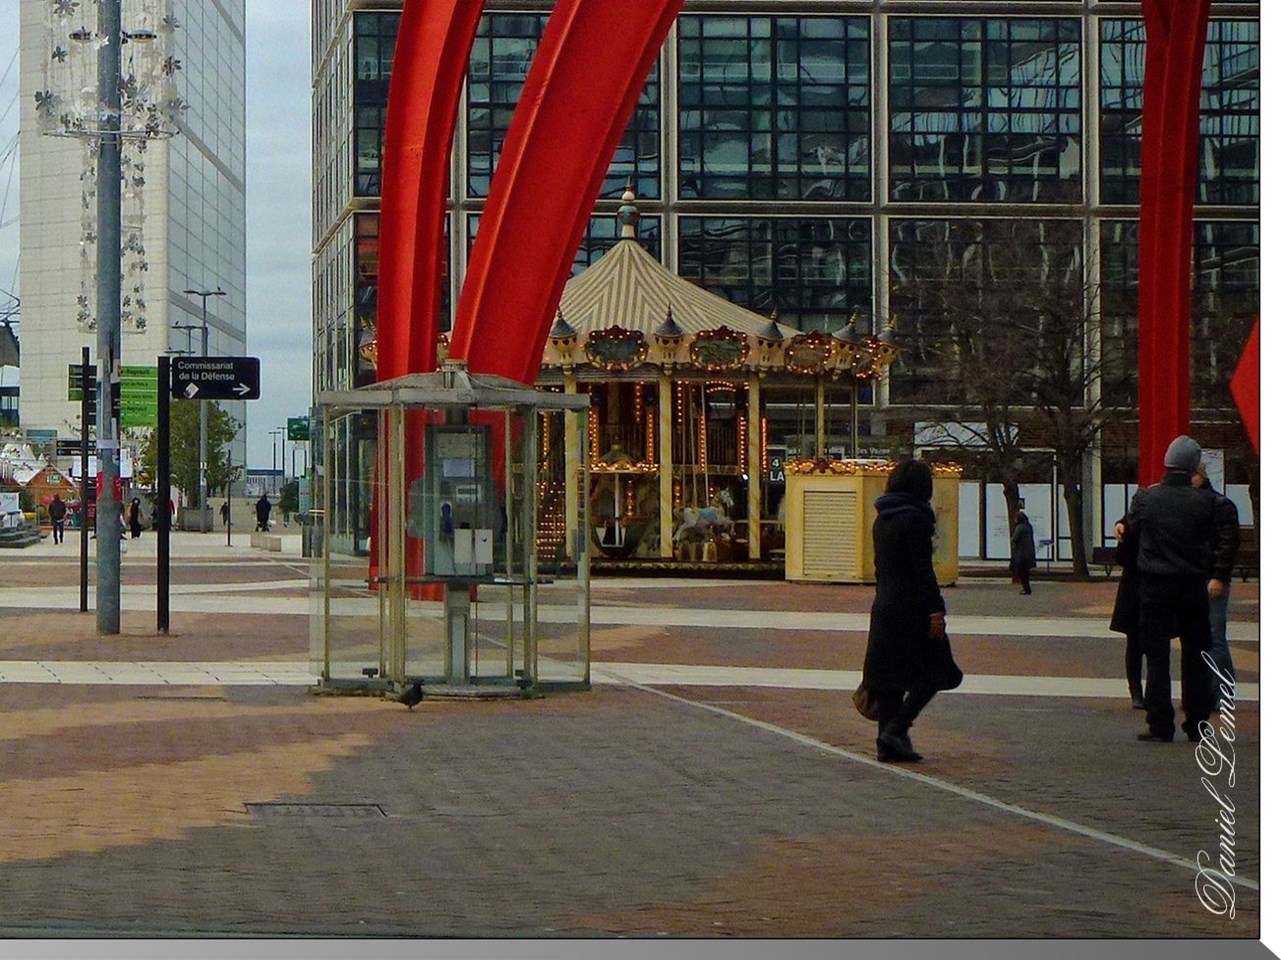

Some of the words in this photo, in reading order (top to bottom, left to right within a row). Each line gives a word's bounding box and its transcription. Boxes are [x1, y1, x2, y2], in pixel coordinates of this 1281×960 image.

[178, 361, 233, 370] Commissariat
[179, 372, 189, 380] de
[191, 372, 199, 380] la
[201, 371, 235, 380] Défense
